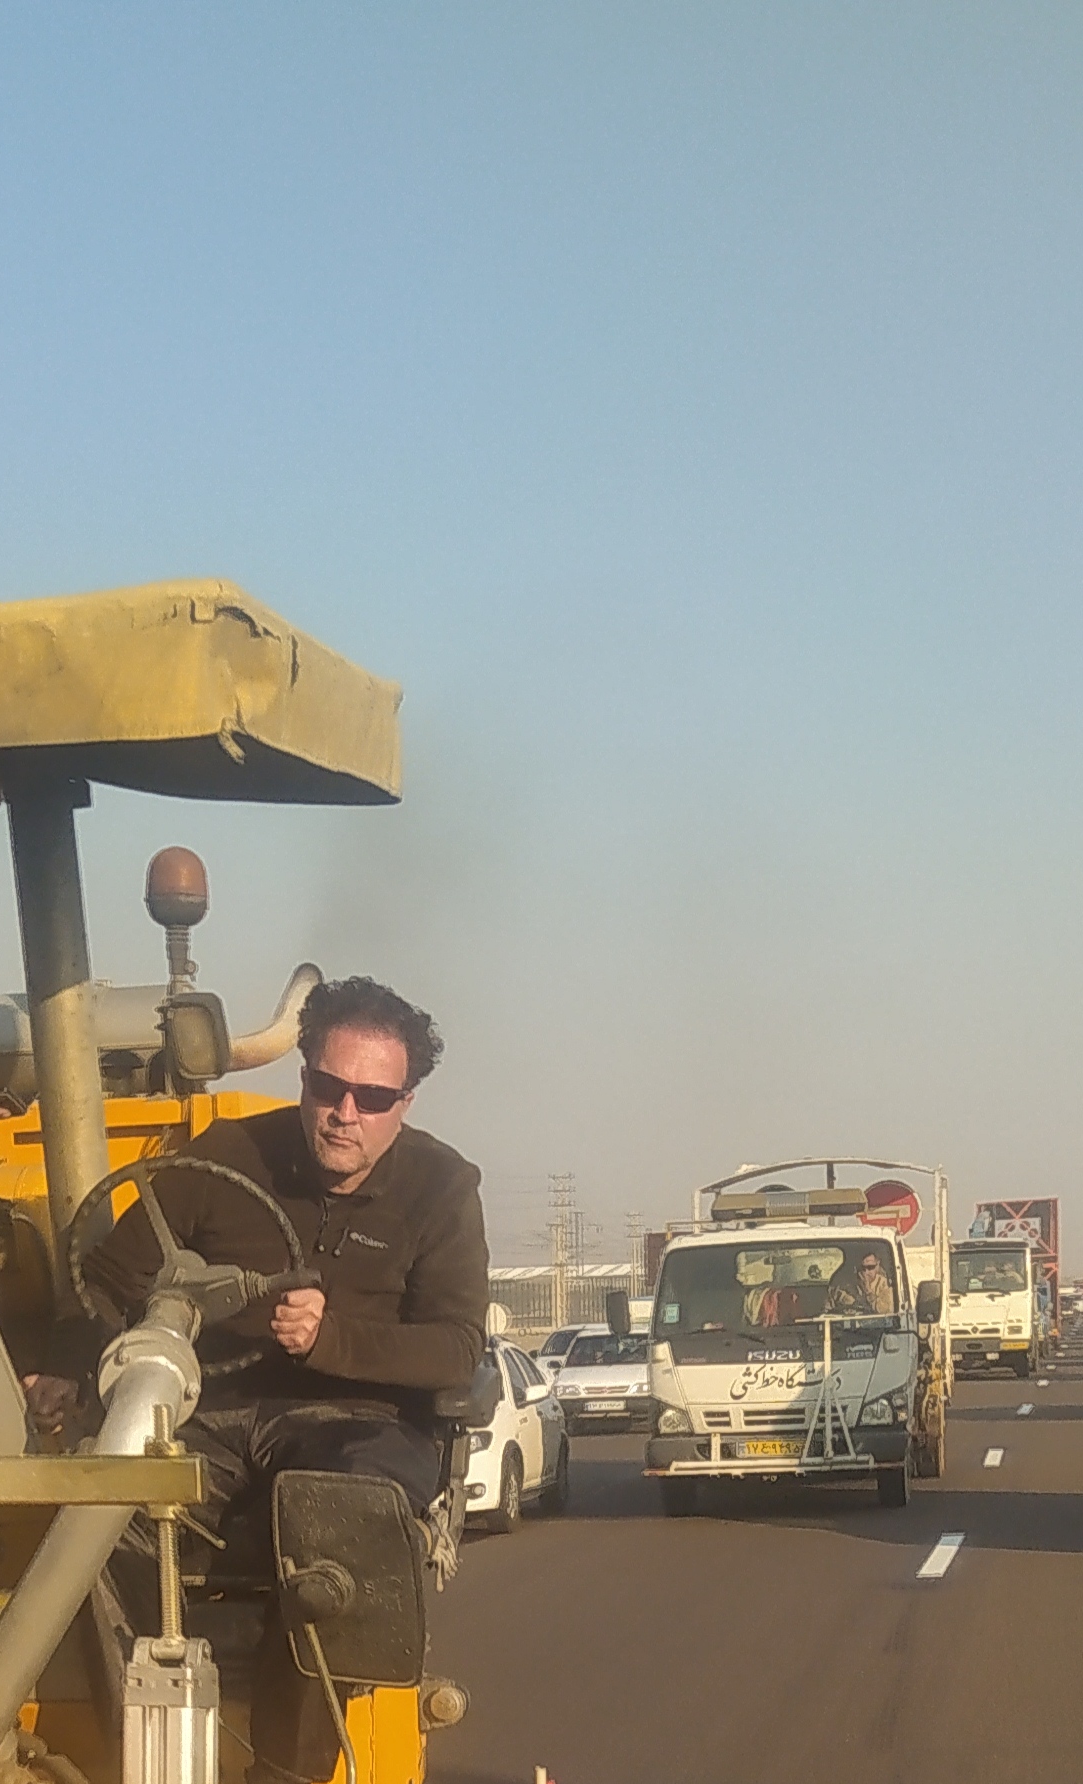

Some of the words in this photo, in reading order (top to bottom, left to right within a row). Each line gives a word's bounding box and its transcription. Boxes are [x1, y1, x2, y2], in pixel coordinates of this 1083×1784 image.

[747, 1349, 801, 1362] ISUZU
[729, 1364, 766, 1400] کشی
[757, 1366, 778, 1390] خط
